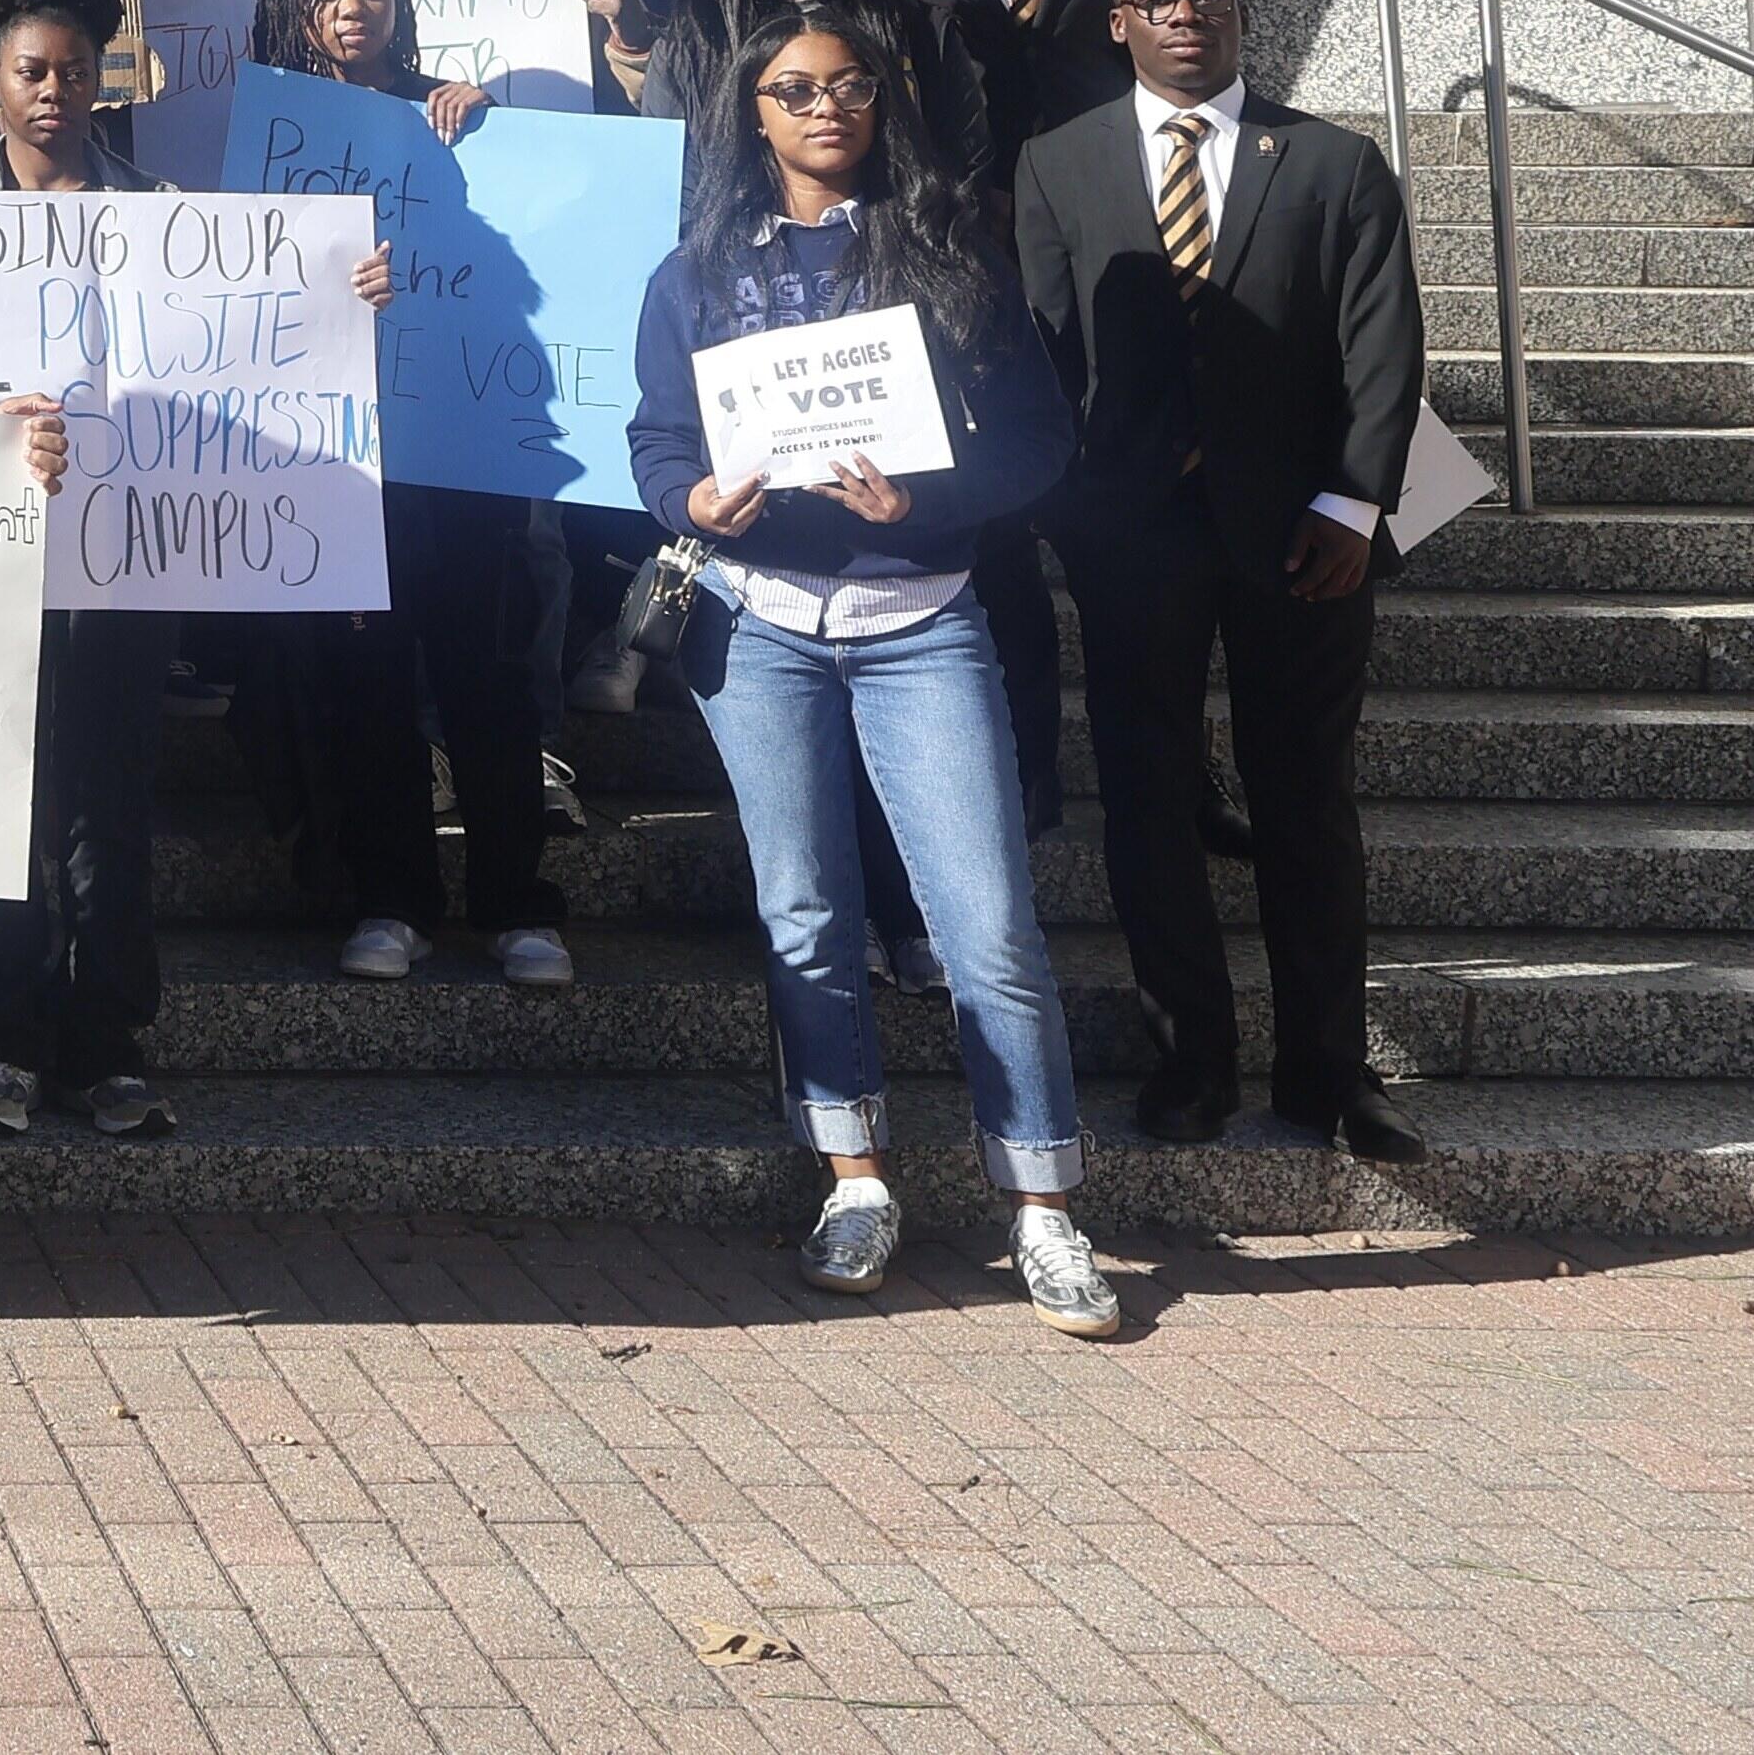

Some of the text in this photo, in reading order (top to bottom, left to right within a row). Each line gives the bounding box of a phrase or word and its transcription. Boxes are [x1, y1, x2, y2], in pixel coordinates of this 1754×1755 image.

[262, 117, 430, 231] Protect
[163, 201, 310, 289] OUR
[39, 277, 309, 379] POLLSITE
[773, 340, 892, 381] LET AGGIES
[460, 335, 622, 409] VOTE
[788, 377, 889, 414] VOTE
[60, 379, 381, 480] SUPPRESSING
[771, 433, 883, 455] ACCESS IS POWER!!
[772, 417, 874, 438] STUDENT VOICES MATTER
[80, 483, 321, 587] CAMPUS
